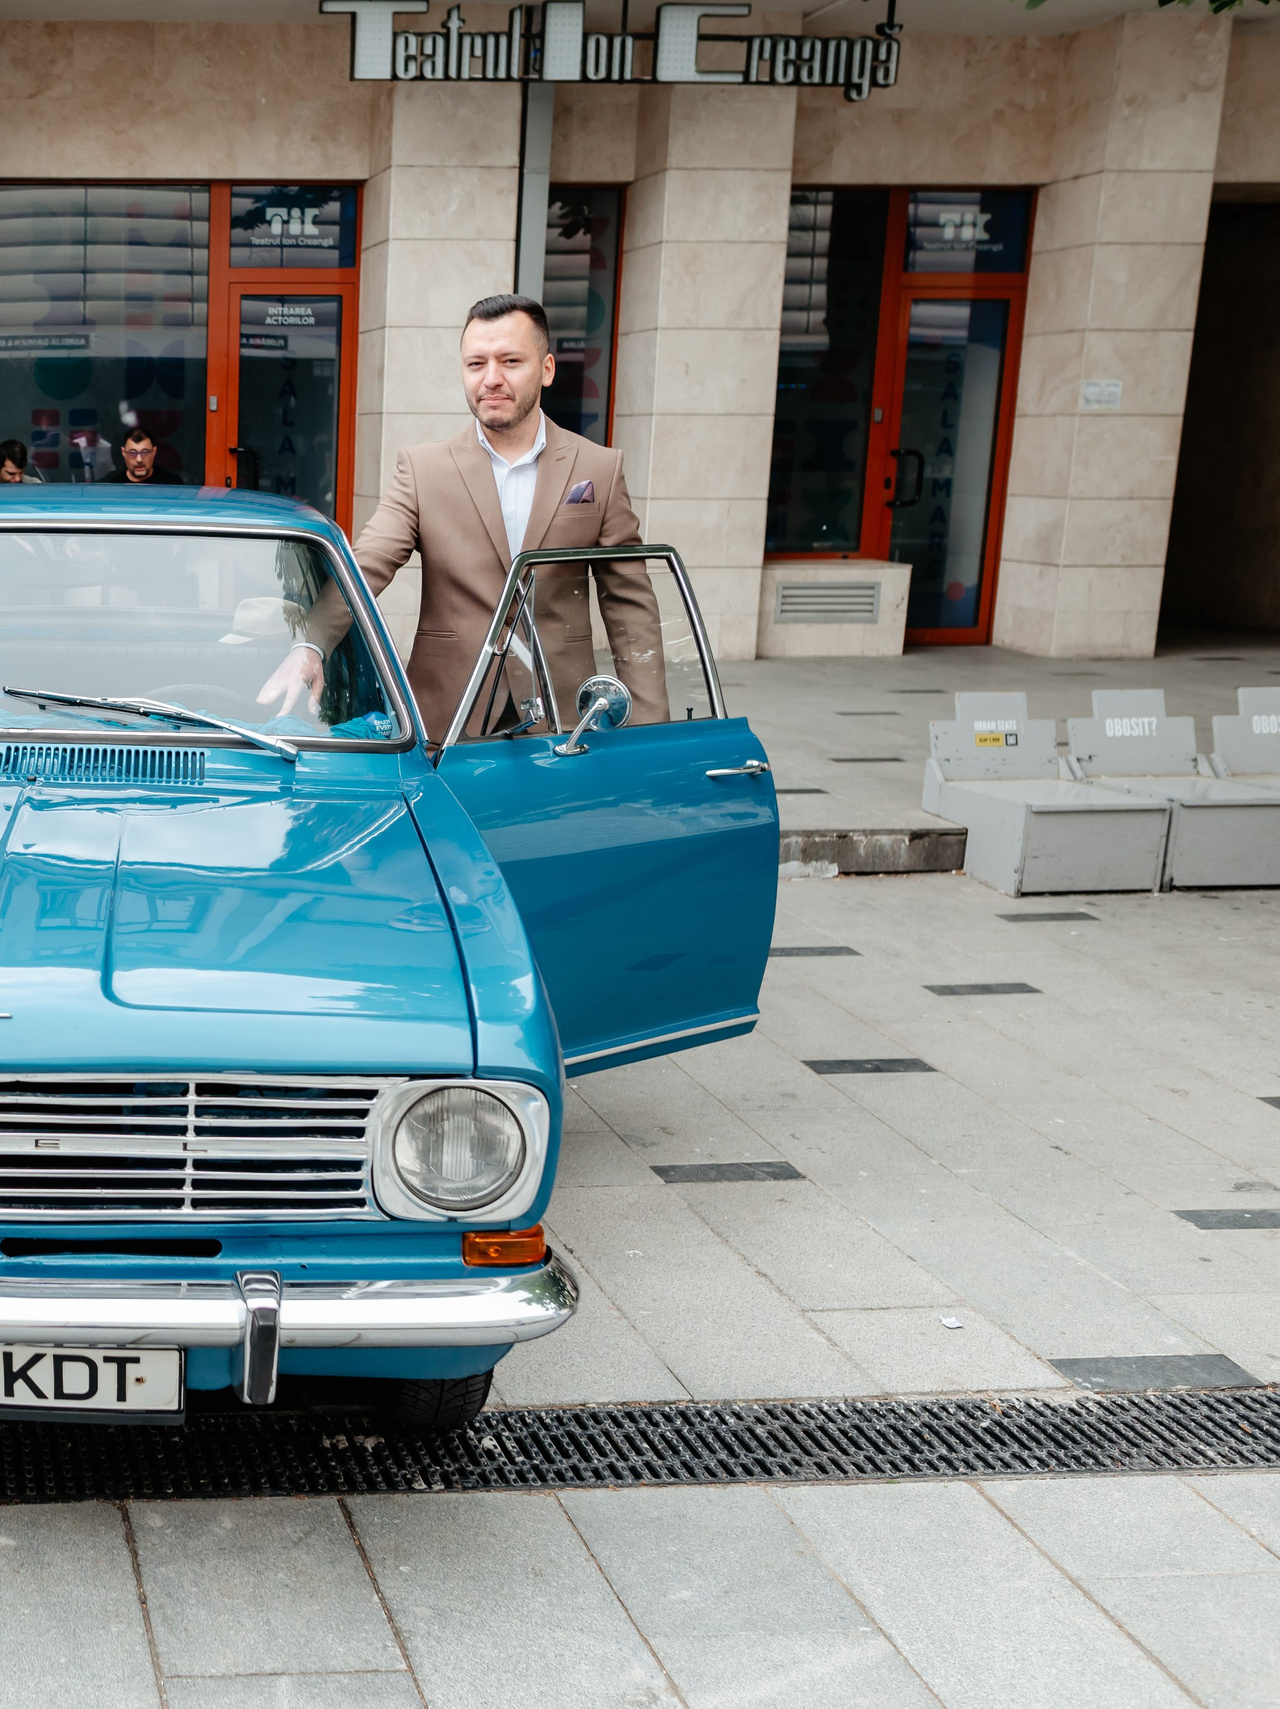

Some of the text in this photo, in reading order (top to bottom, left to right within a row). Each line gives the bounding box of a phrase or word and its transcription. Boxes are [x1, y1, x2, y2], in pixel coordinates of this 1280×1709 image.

[320, 1, 522, 80] Teatrul
[542, 1, 634, 81] Ion
[250, 237, 280, 246] Teatrul
[282, 237, 296, 246] Ion
[268, 307, 312, 316] INTRAREA
[265, 317, 315, 326] ACTORILOR
[936, 353, 962, 457] SALA
[974, 720, 1017, 731] URBAN SEATS
[1105, 717, 1157, 737] OBOSIT?
[1252, 715, 1280, 734] OBO
[3, 1351, 141, 1402] KDT
